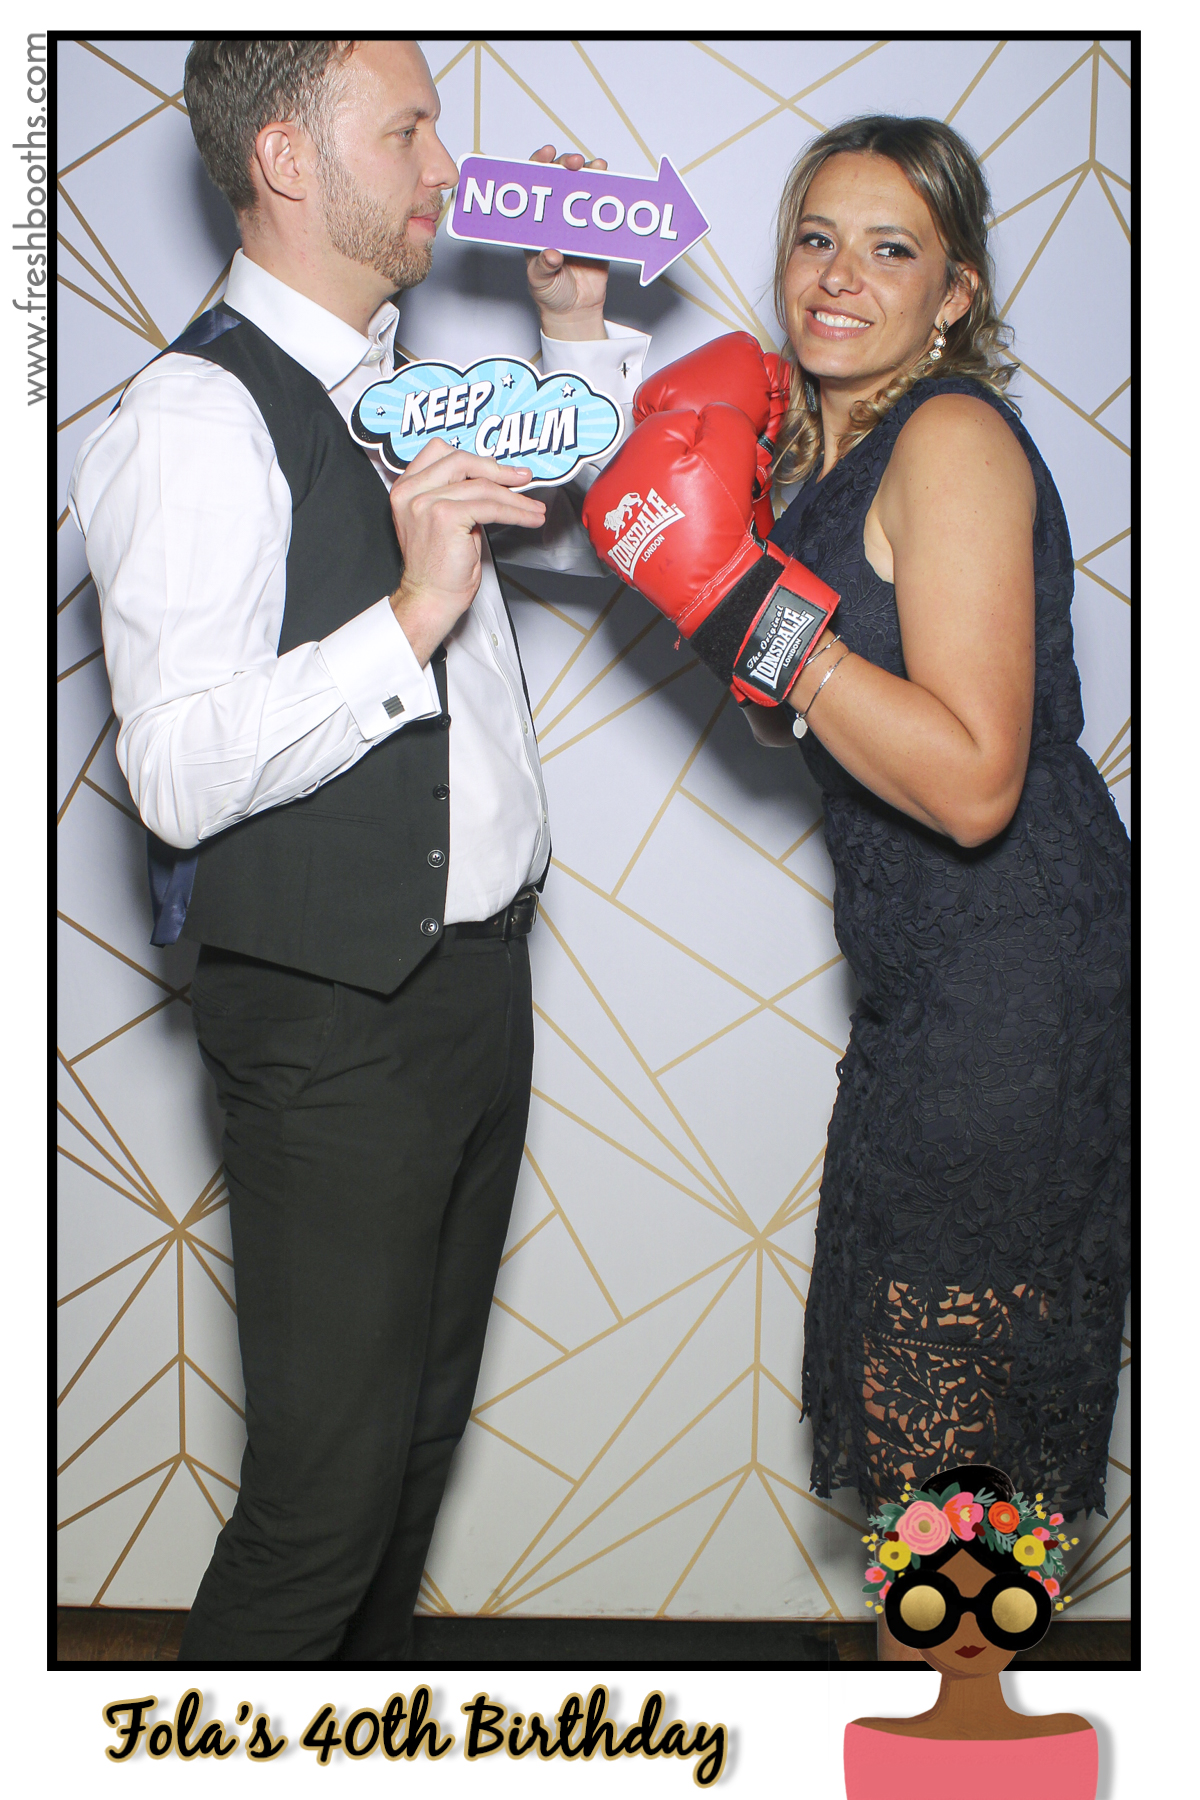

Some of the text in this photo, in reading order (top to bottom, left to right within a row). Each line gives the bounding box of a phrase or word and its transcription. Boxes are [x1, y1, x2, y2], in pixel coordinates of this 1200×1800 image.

[462, 177, 679, 241] NOT COOL
[400, 380, 495, 438] KEEP
[474, 405, 579, 461] CALM
[607, 488, 686, 580] LONSDALE
[640, 533, 666, 563] LONDON
[746, 604, 784, 669] The Original
[749, 607, 816, 690] LONSDALE
[783, 637, 803, 669] LONDON
